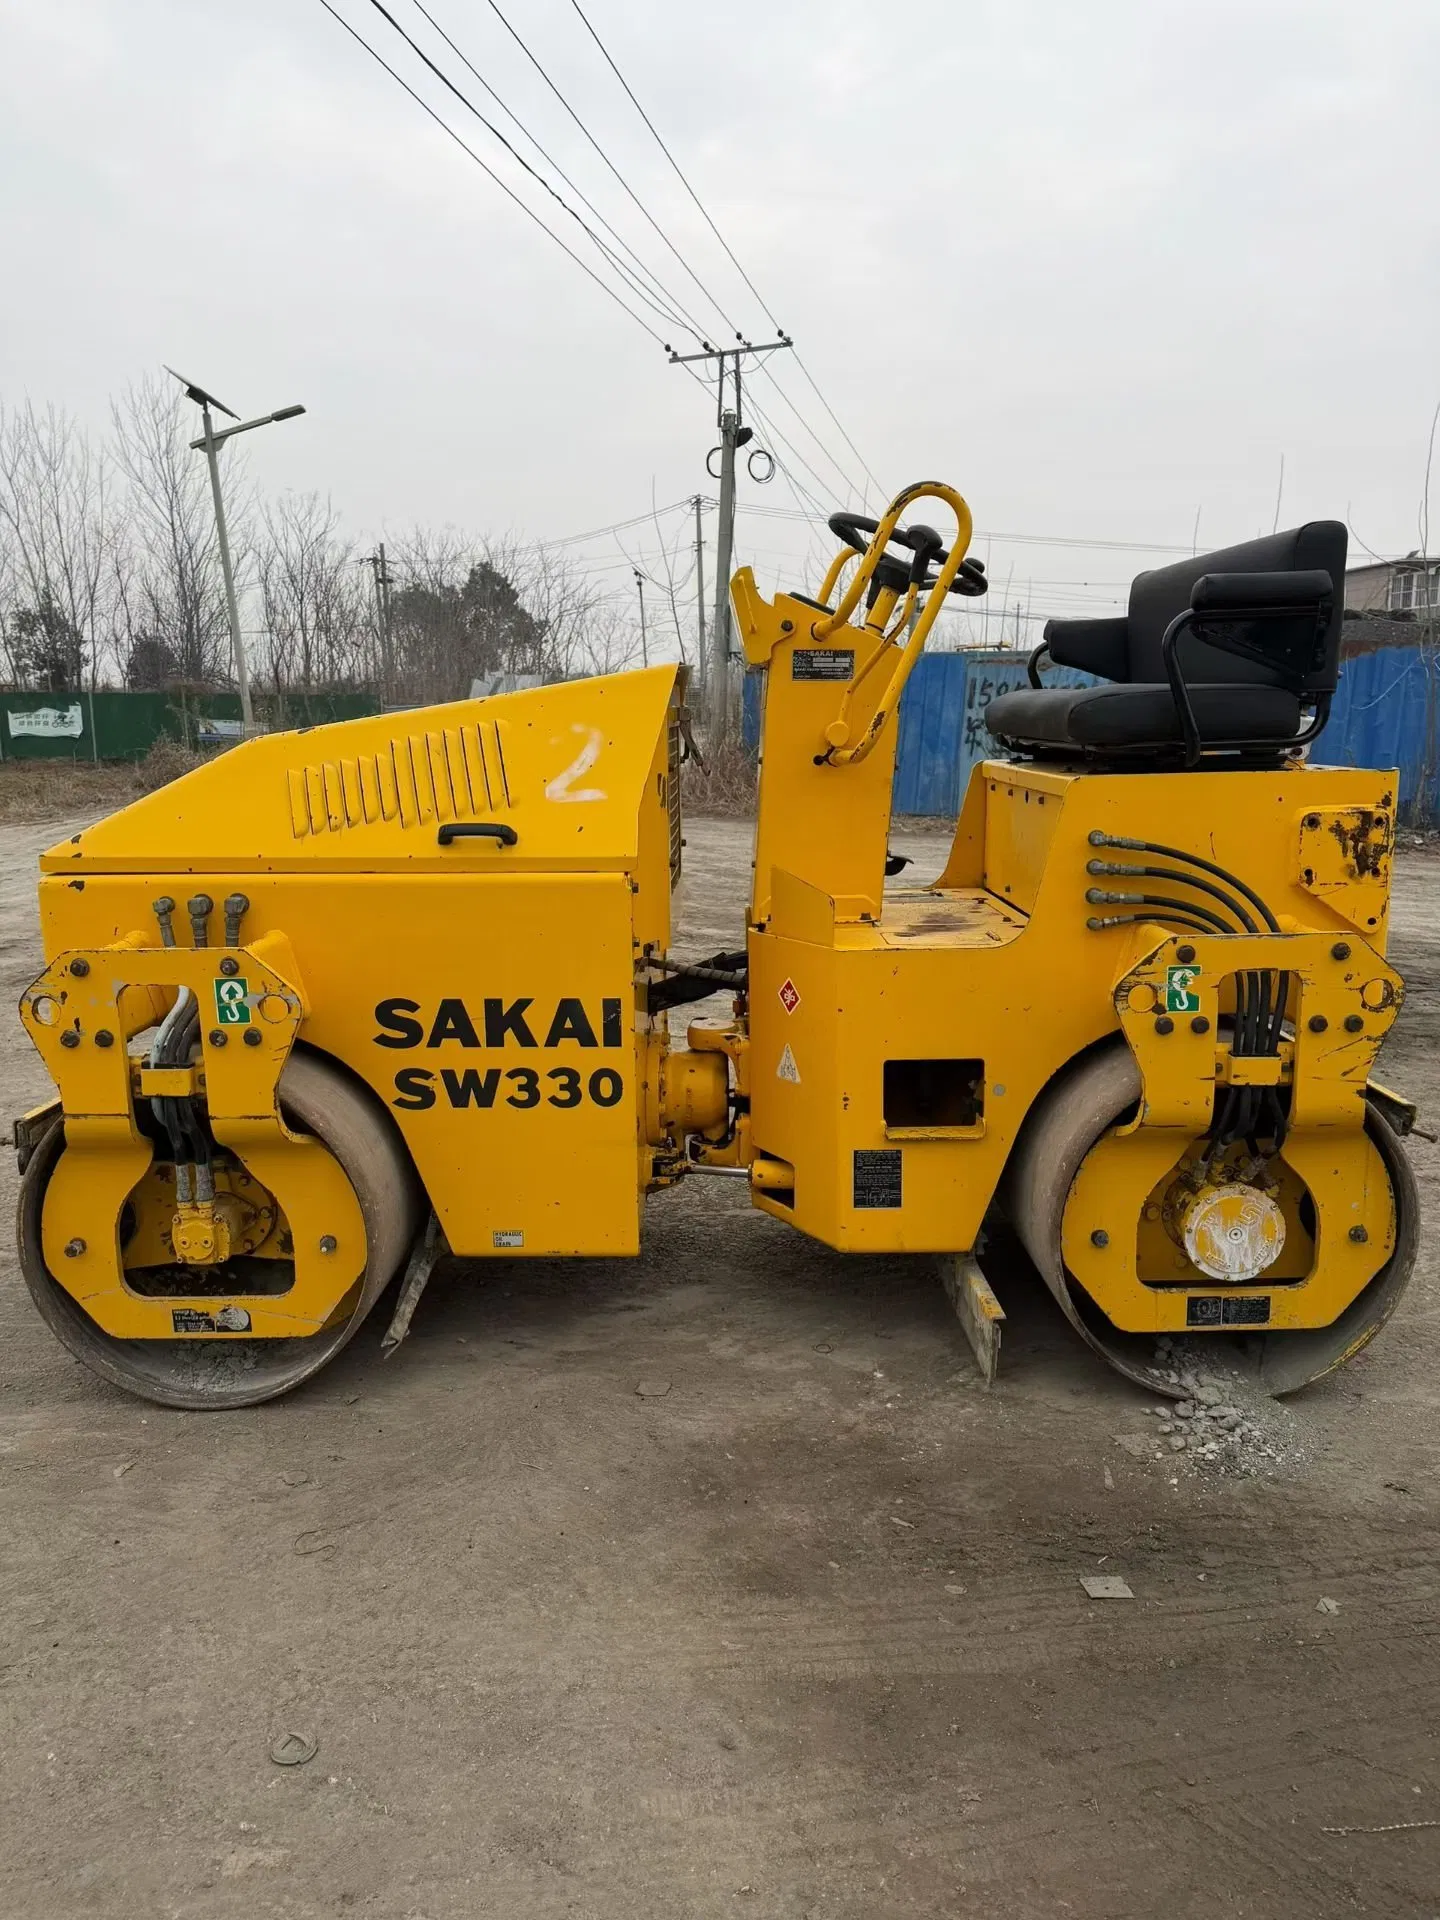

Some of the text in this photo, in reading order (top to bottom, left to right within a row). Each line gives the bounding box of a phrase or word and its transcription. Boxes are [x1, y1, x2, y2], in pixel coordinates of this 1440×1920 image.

[545, 724, 608, 803] 2
[372, 998, 623, 1049] SAKAI
[391, 1067, 624, 1110] SW330
